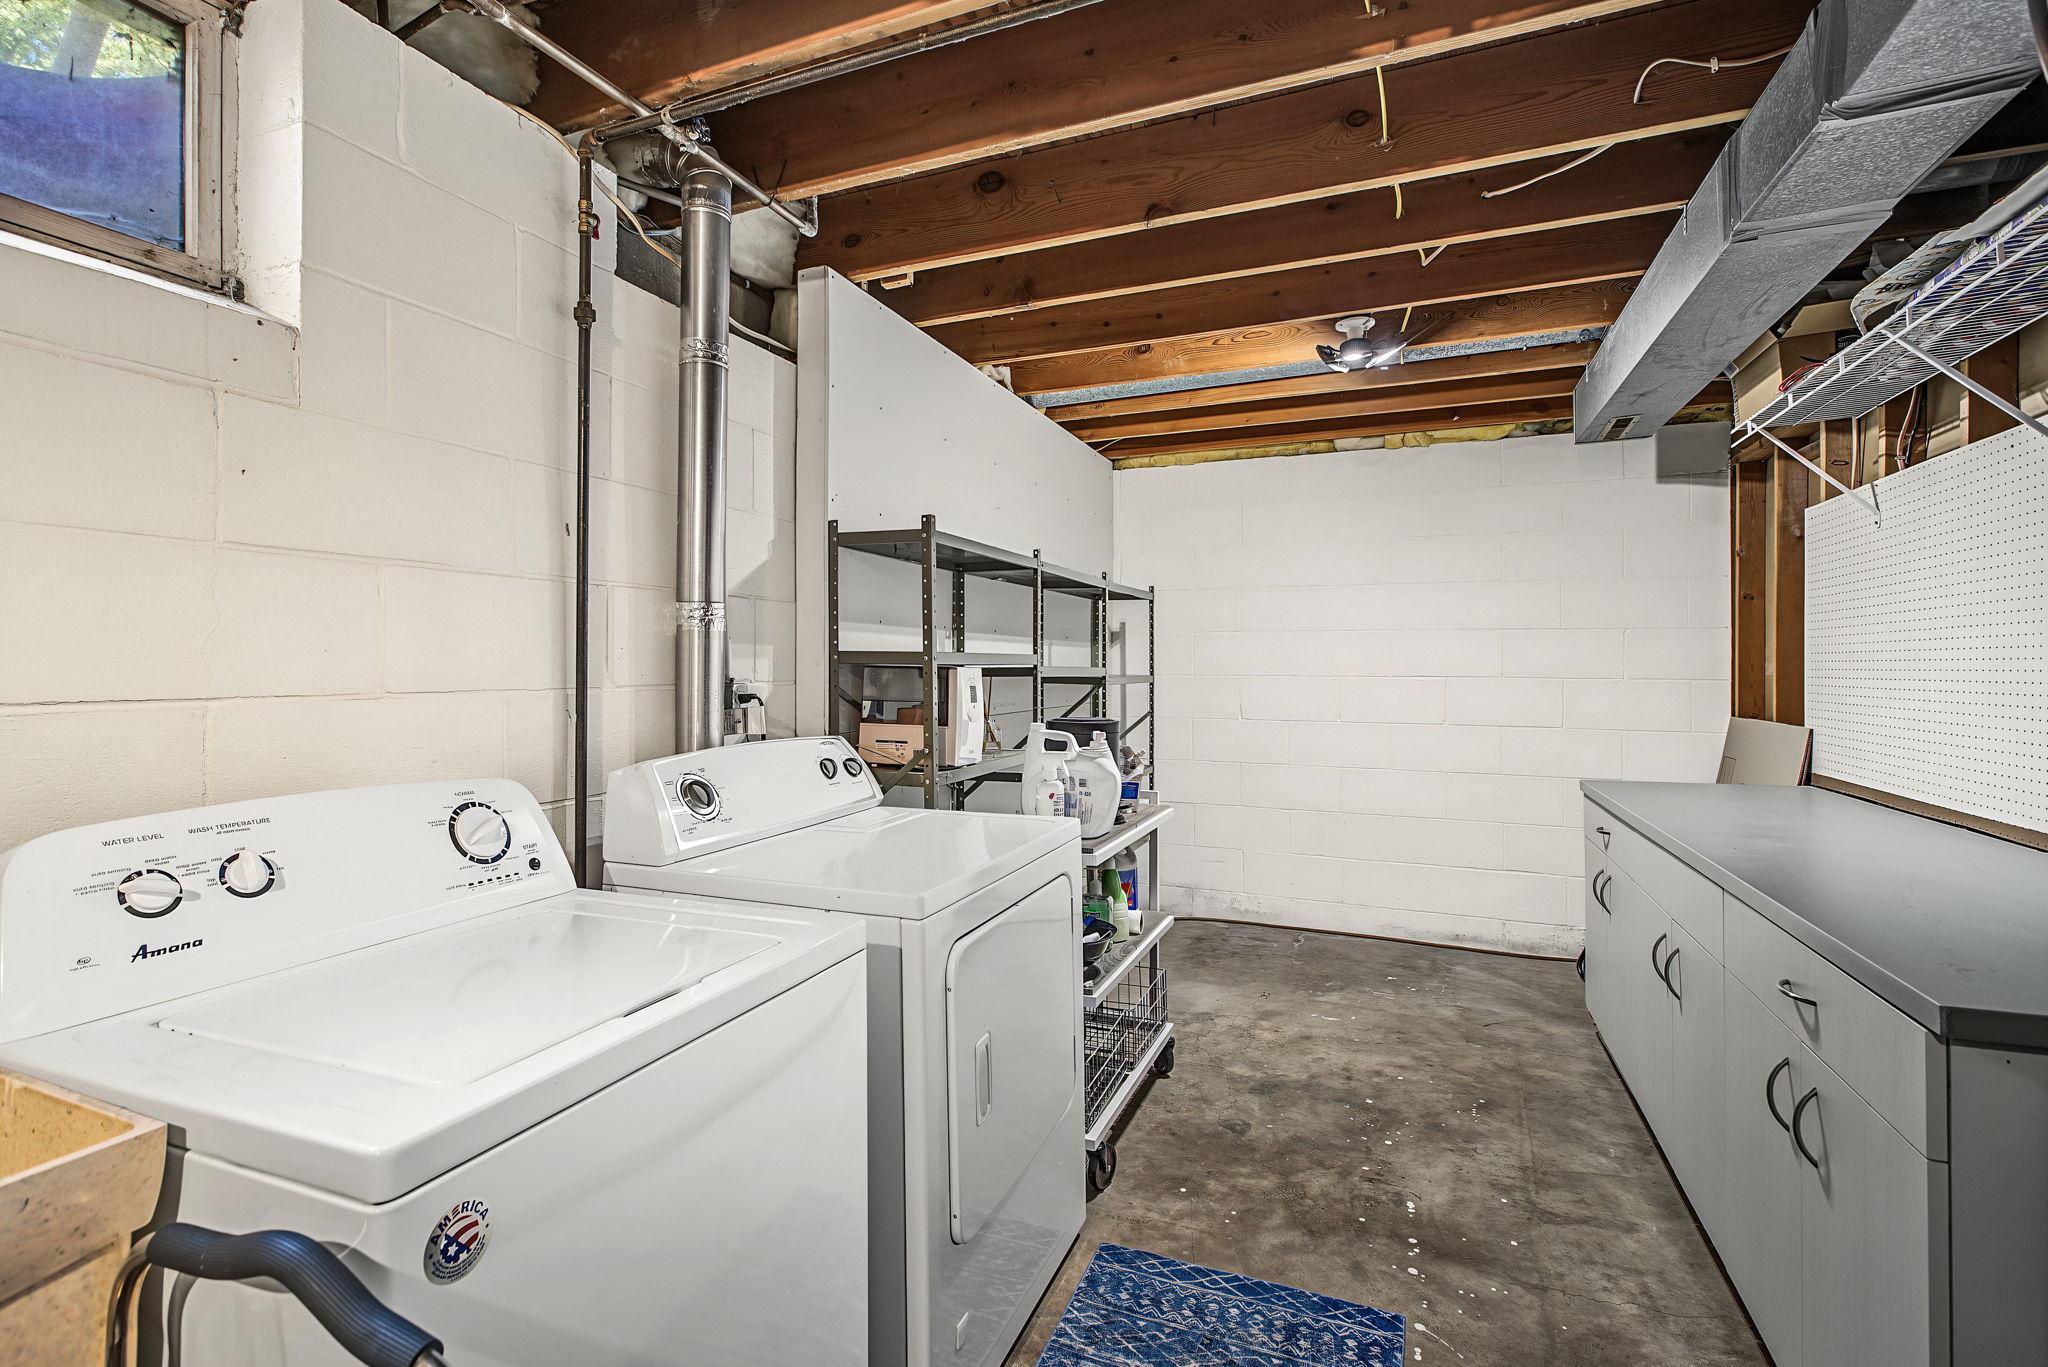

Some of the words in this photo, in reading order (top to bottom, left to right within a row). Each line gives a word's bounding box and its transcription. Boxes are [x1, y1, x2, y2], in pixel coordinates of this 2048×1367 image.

[187, 825, 214, 834] WASH
[215, 817, 271, 830] TEMPERATURE
[101, 836, 135, 848] WATER
[136, 832, 165, 842] LEVEL
[131, 938, 204, 963] Amana
[431, 1199, 489, 1246] AMERICA
